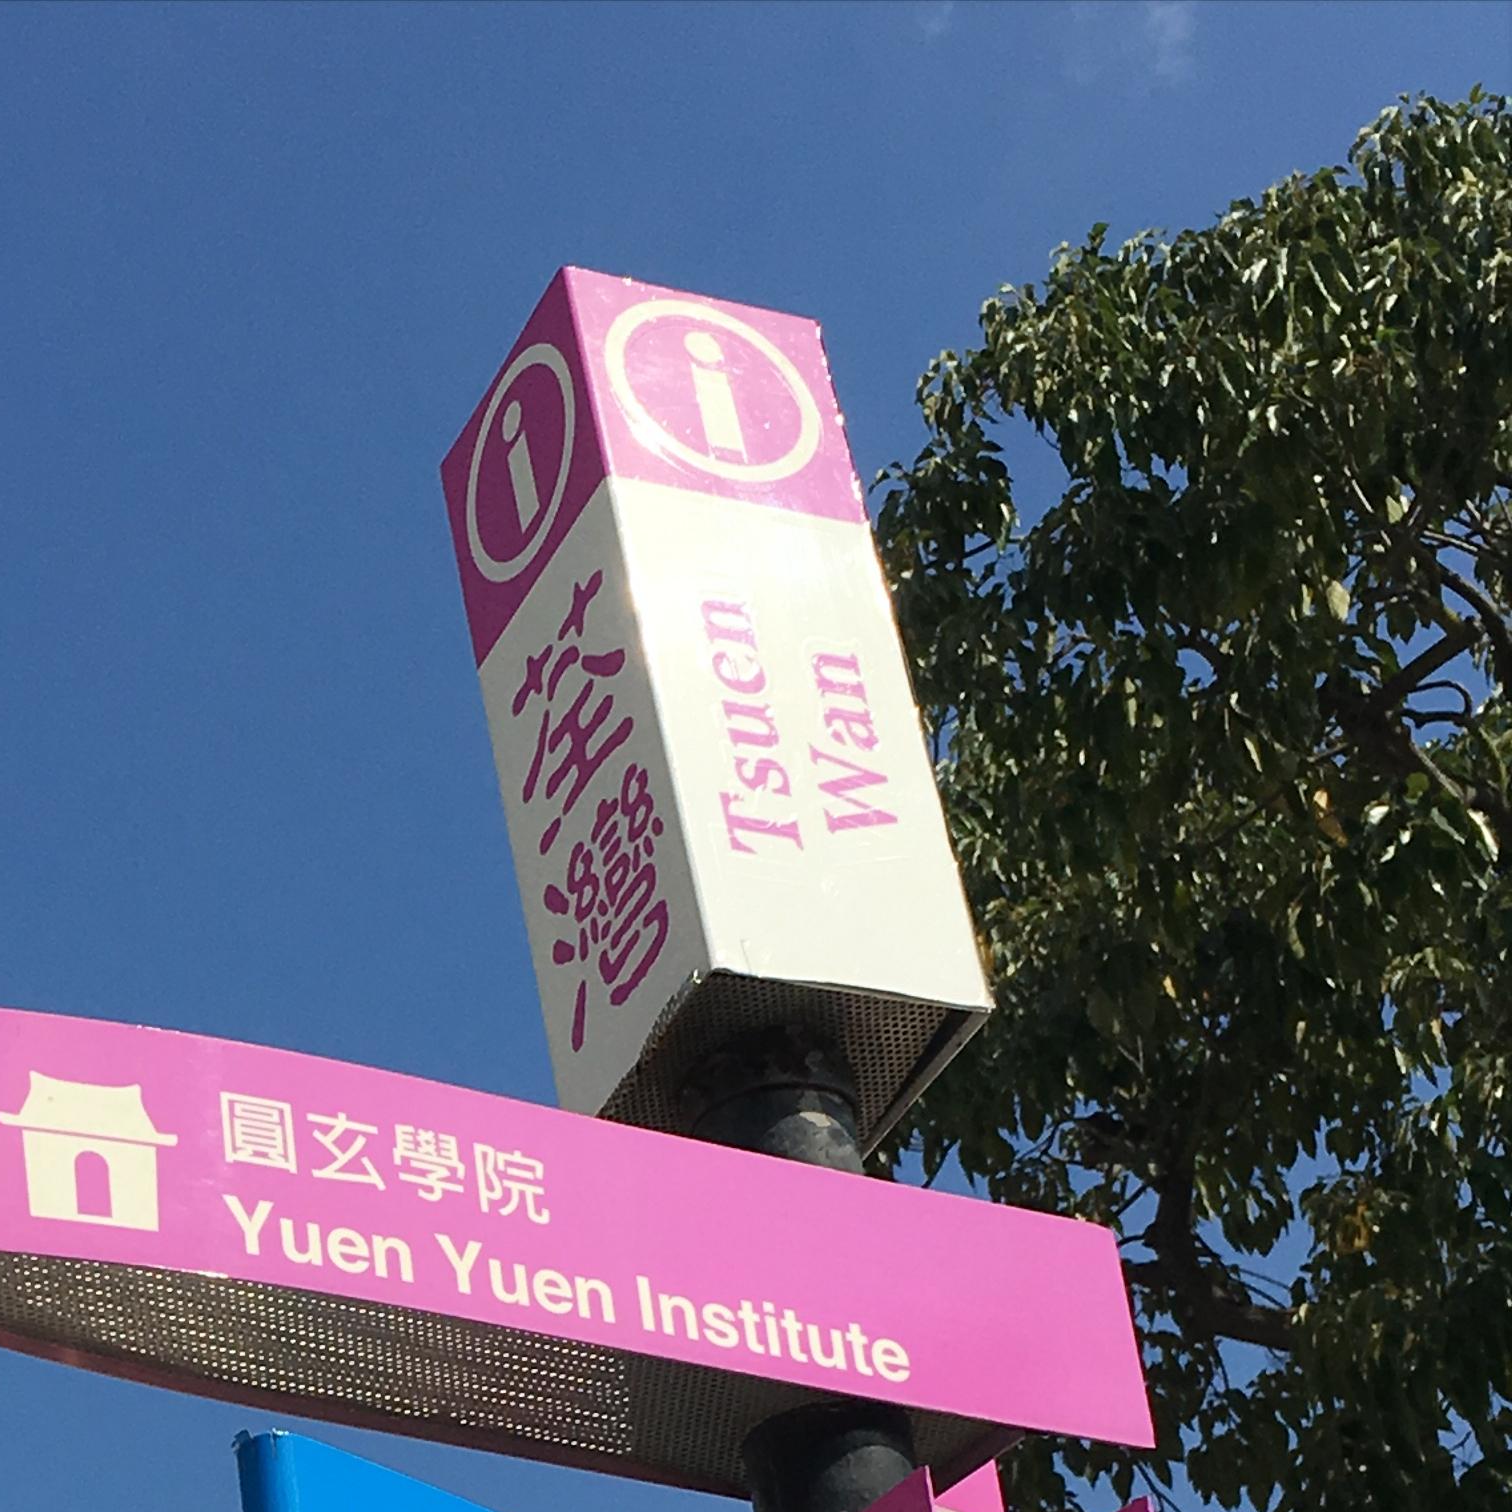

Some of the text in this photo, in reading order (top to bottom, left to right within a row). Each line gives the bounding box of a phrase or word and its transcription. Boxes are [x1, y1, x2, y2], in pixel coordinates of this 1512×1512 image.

[702, 601, 804, 855] Tsuen
[809, 652, 899, 839] Wan
[219, 1091, 551, 1225] 圓玄學院
[223, 1195, 911, 1384] Yuen Yuen Institute
